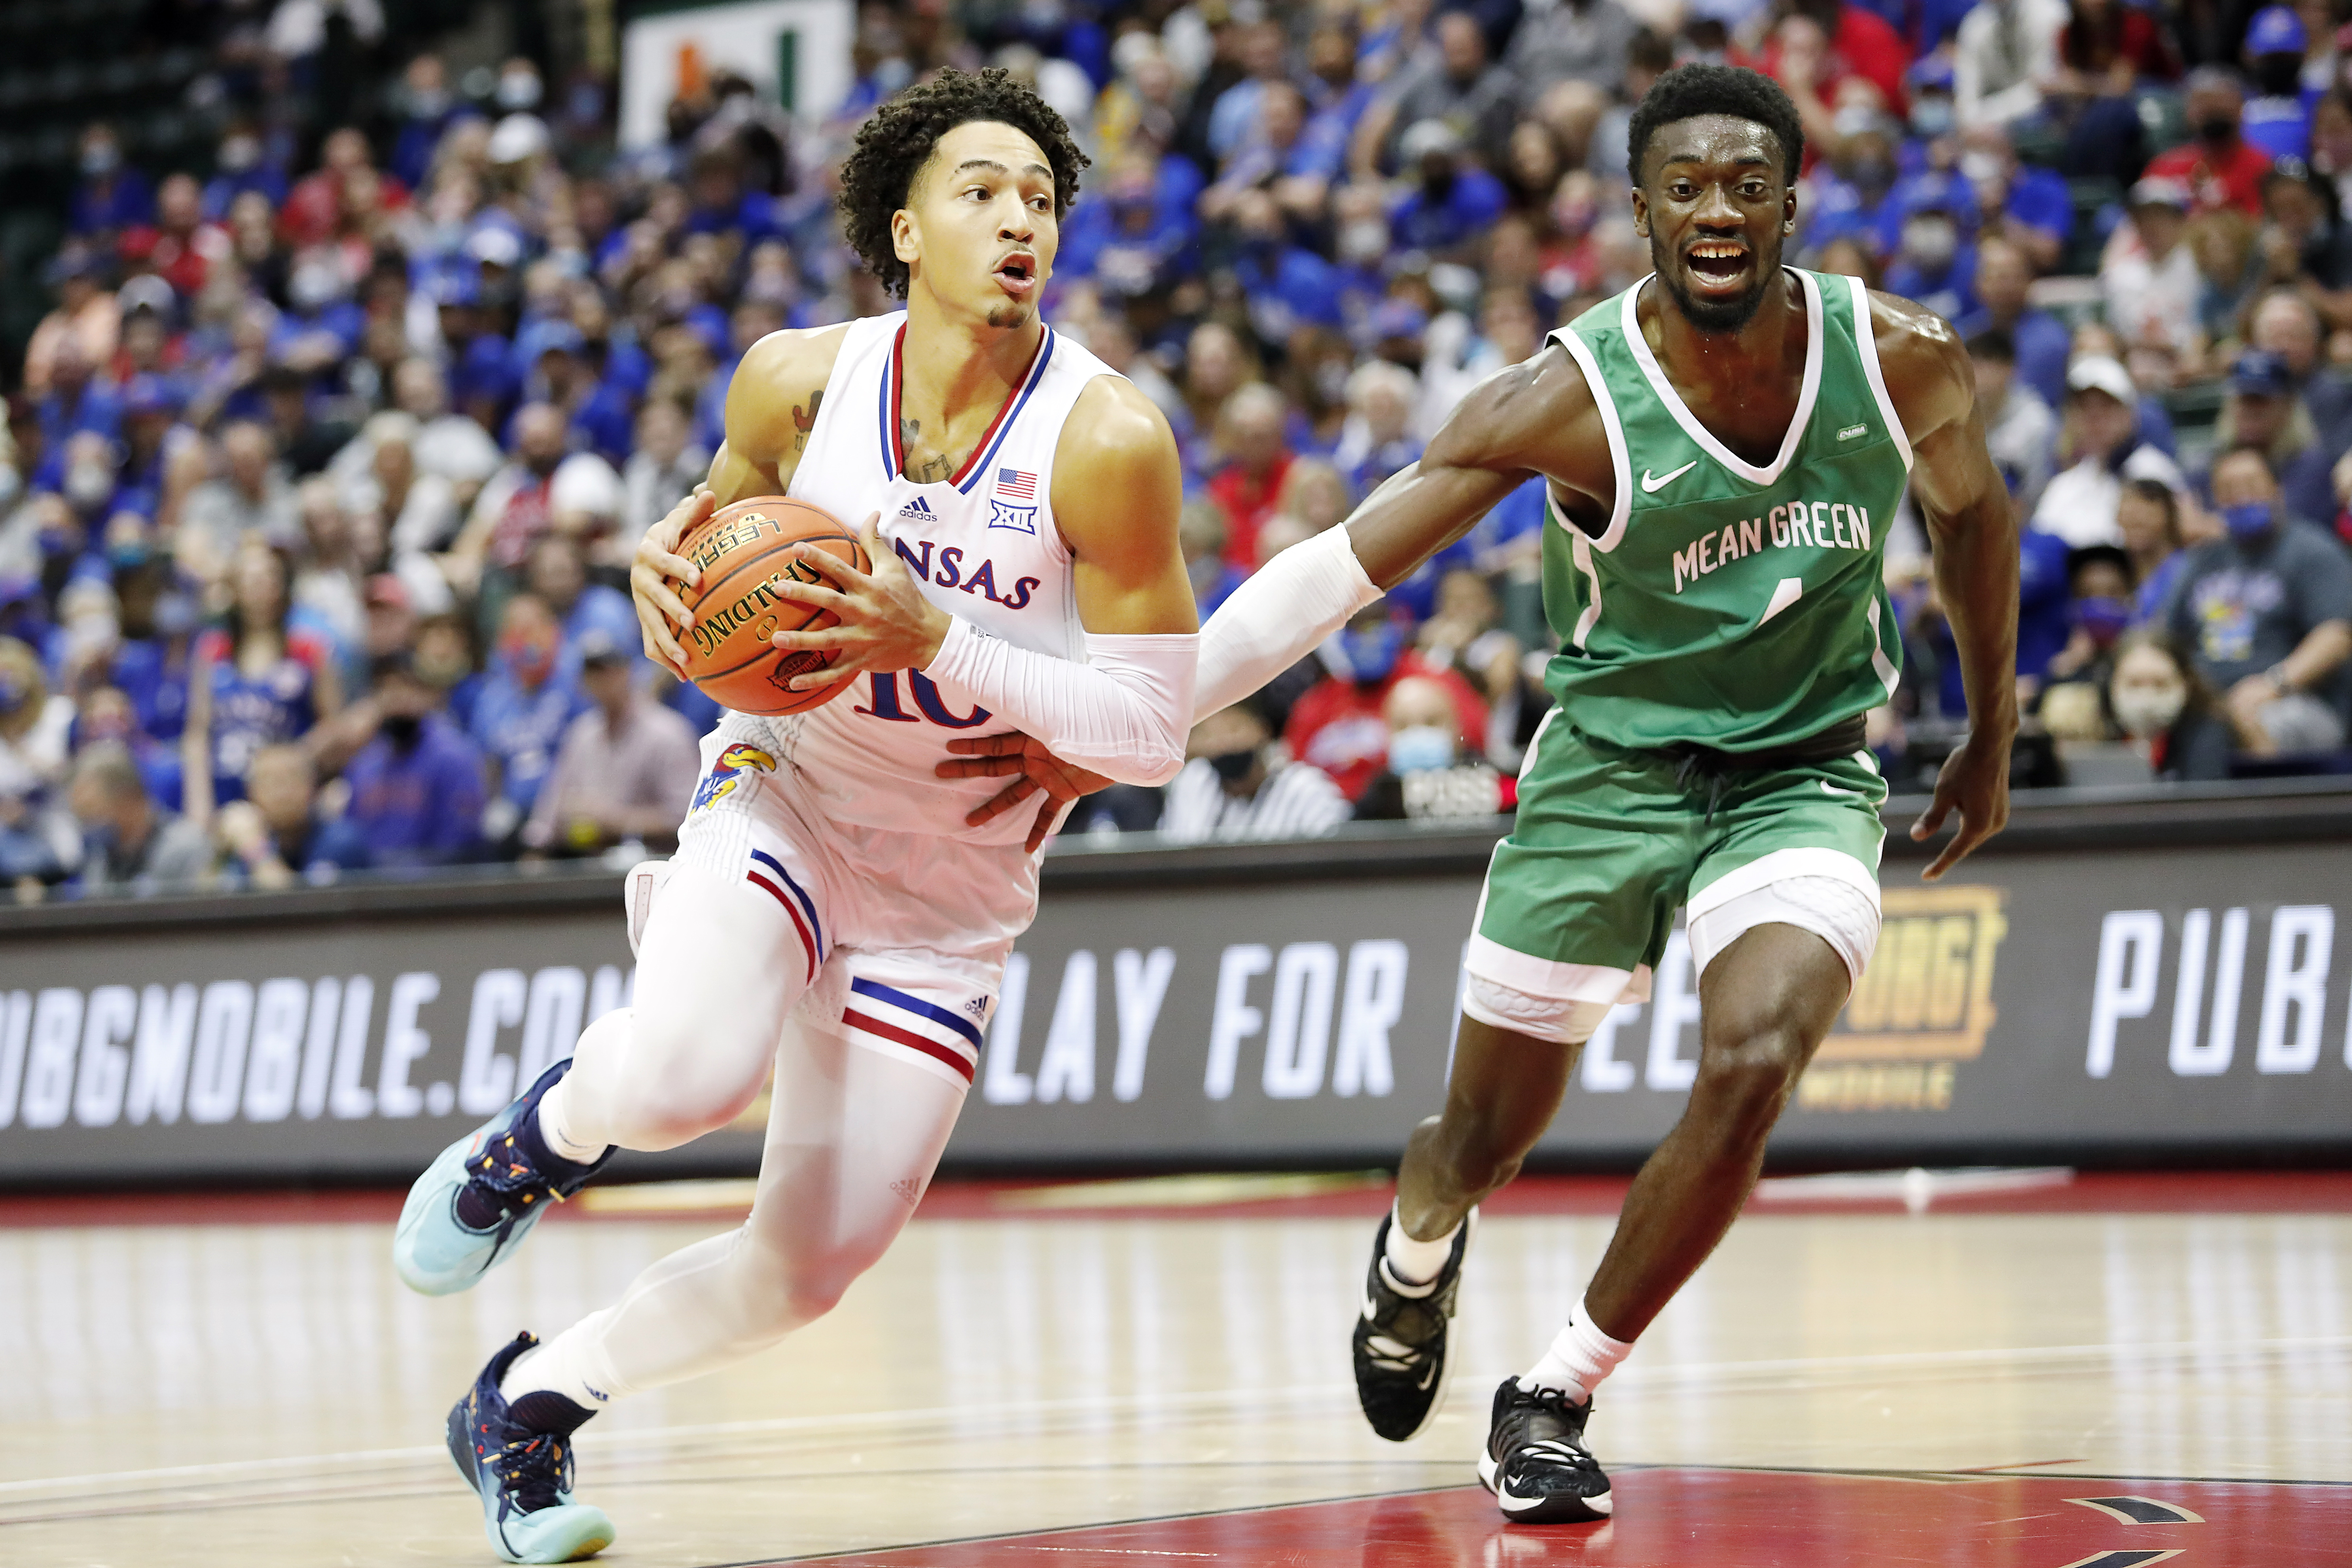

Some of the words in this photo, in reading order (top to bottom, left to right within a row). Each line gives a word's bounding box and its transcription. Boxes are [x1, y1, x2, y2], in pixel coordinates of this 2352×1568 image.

[678, 518, 783, 600] LEGAY
[899, 509, 937, 522] adidas
[1673, 517, 1761, 595] MEAN
[1768, 500, 1871, 551] GREEN
[896, 537, 1041, 610] NSAS
[983, 946, 1176, 1105] LAY
[1203, 938, 1409, 1100] FOR
[2085, 904, 2352, 1079] PUB
[0, 965, 635, 1130] BGMOBILE.CO
